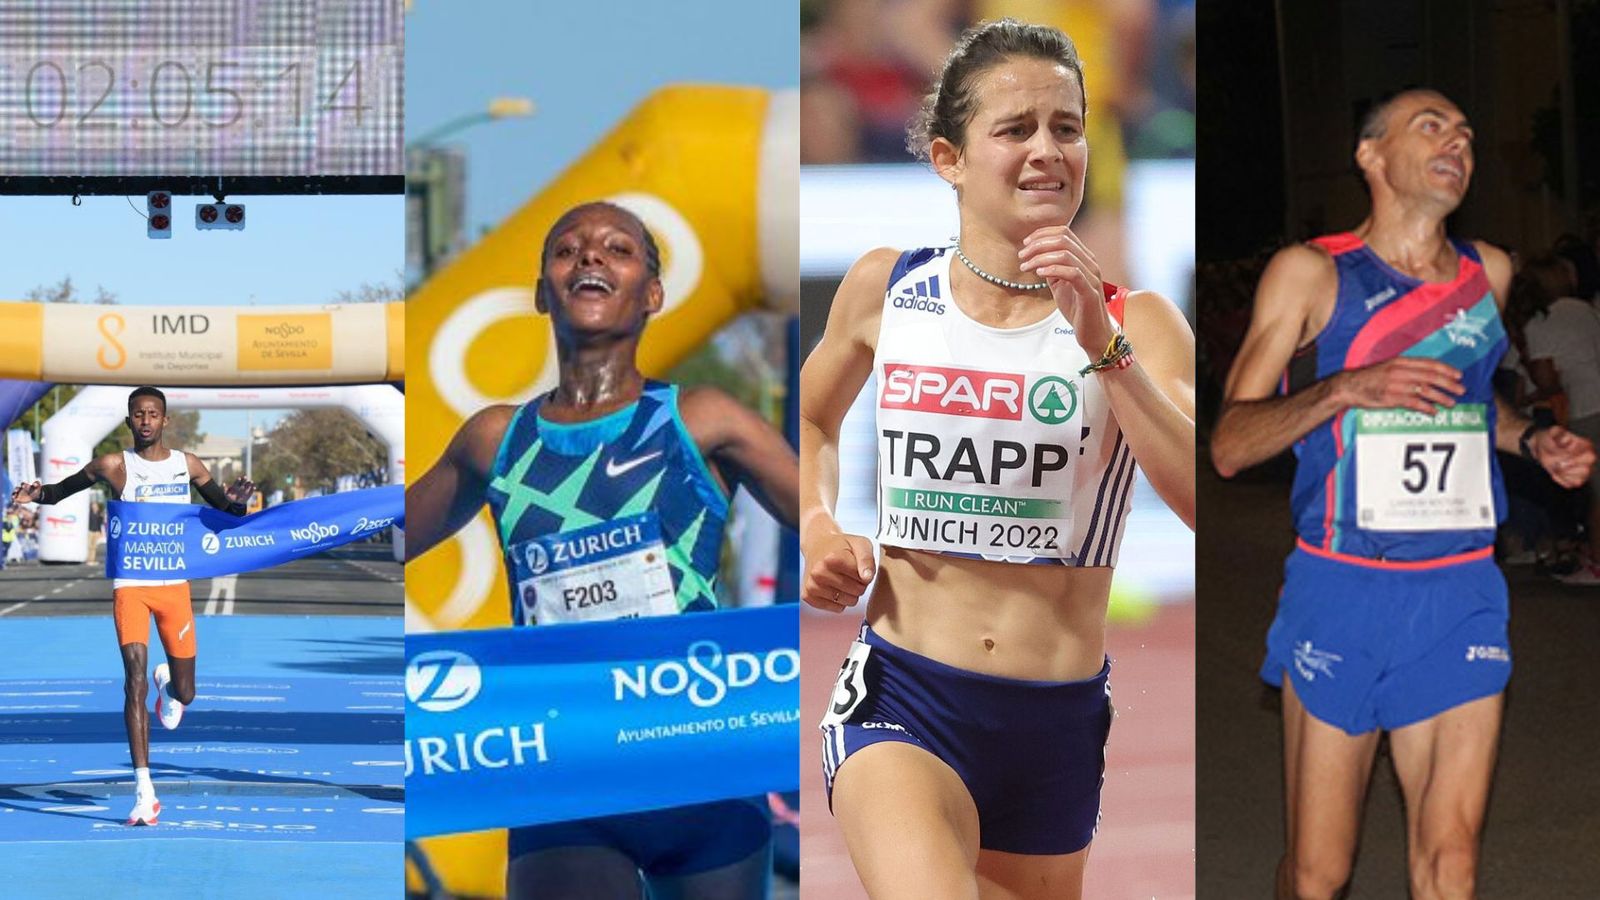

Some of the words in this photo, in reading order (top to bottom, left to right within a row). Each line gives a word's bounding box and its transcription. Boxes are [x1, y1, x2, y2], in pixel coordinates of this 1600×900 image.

[24, 59, 373, 129] 02:05:14
[893, 296, 946, 316] adidas
[152, 314, 210, 335] IMD
[884, 370, 1020, 415] SPAR
[882, 428, 1069, 488] TRAPP
[1402, 442, 1457, 494] 57
[904, 491, 910, 507] I
[914, 493, 952, 511] RUN
[127, 521, 185, 536] ZURICH
[225, 533, 275, 549] ZURICH
[988, 523, 1060, 551] 2022
[124, 540, 185, 554] MARATÓN
[552, 525, 642, 563] ZURICH
[123, 556, 187, 571] SEVILLA
[563, 579, 618, 612] F203
[617, 718, 724, 744] AYUNTAMIENTO
[728, 714, 748, 730] DE
